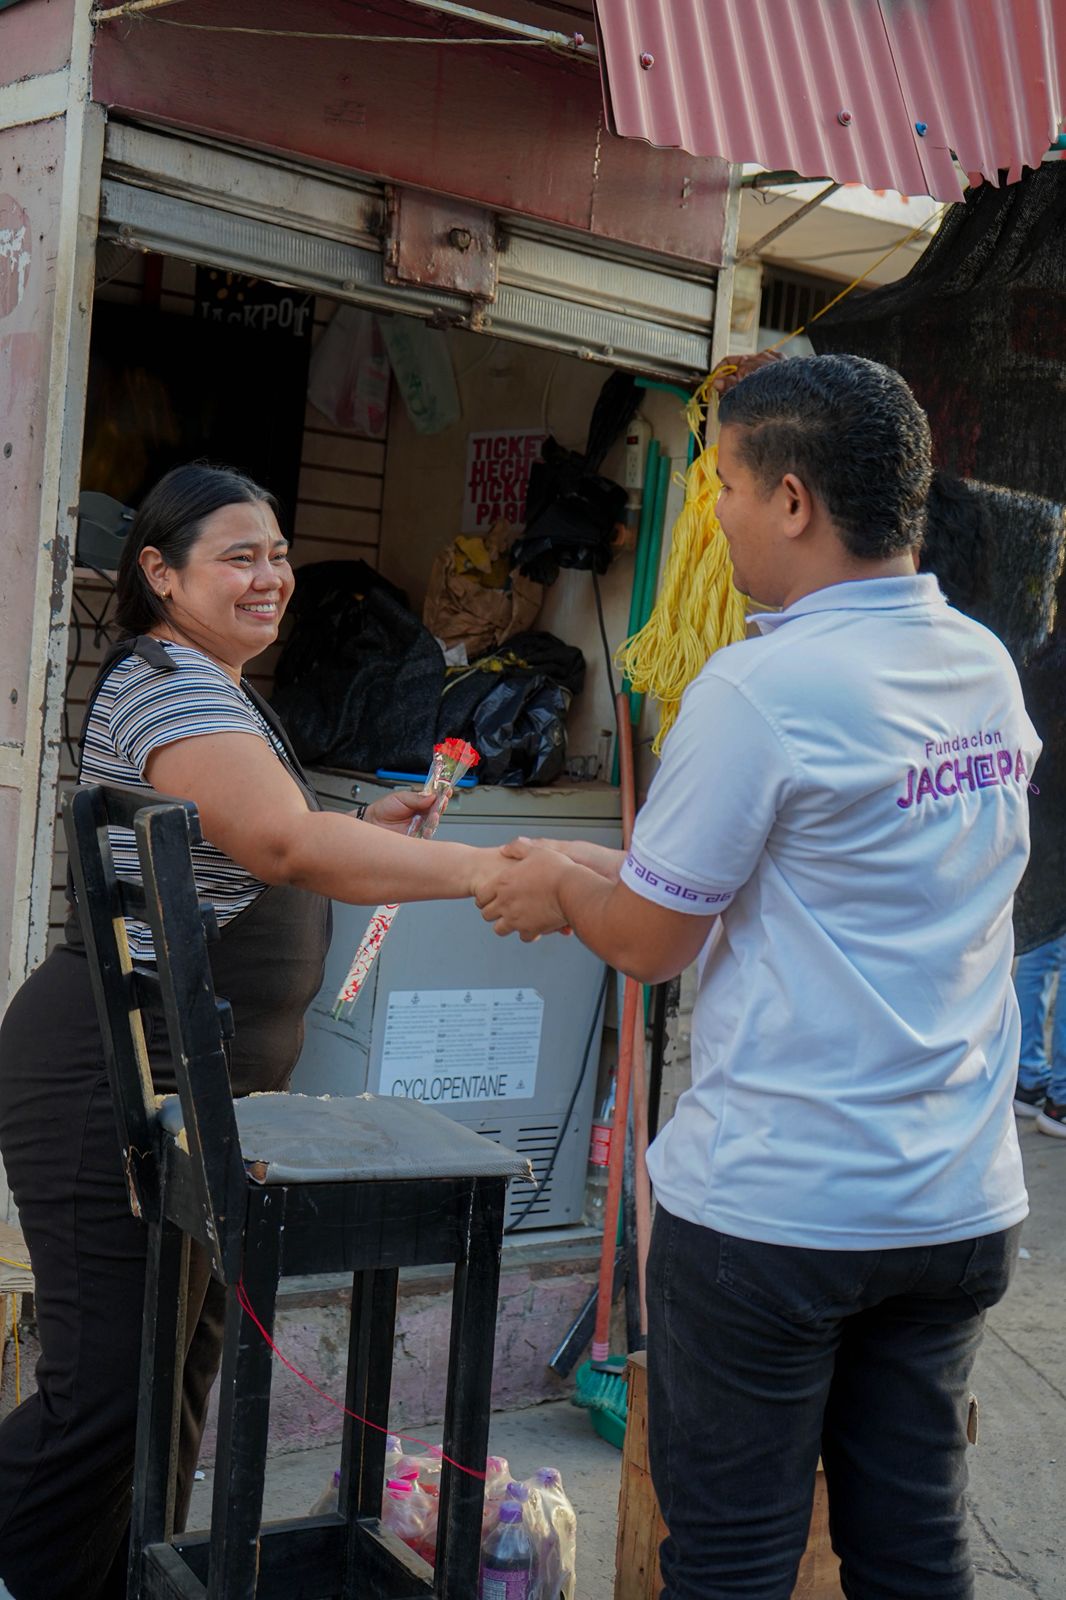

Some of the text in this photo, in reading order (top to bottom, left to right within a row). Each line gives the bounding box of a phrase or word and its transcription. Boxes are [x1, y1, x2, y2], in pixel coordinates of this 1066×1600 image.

[472, 459, 543, 481] HECH
[925, 730, 1002, 759] Fundacion
[392, 1074, 507, 1101] CYCLOPENTANE
